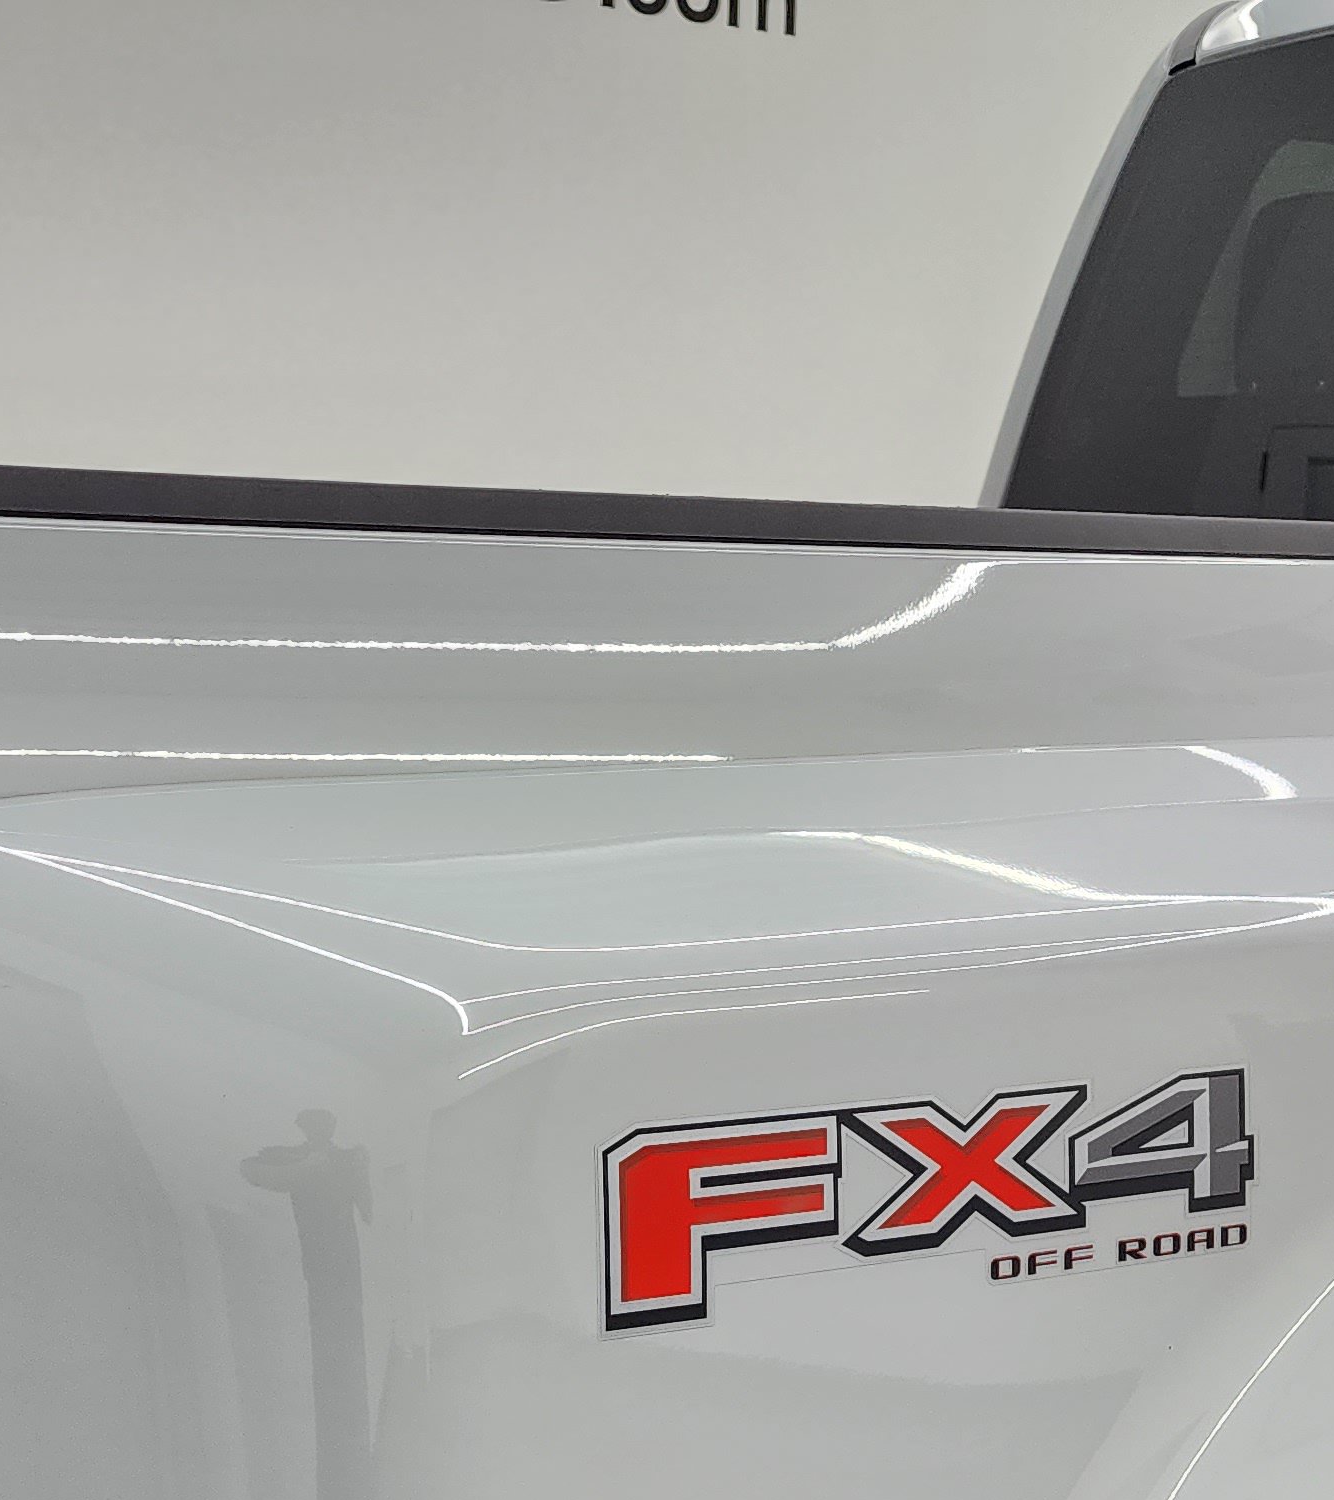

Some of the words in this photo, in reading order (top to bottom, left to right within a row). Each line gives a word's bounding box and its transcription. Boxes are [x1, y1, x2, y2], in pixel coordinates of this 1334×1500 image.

[603, 1068, 1255, 1332] FX4
[990, 1244, 1094, 1281] OFF
[1118, 1223, 1248, 1262] ROAD
